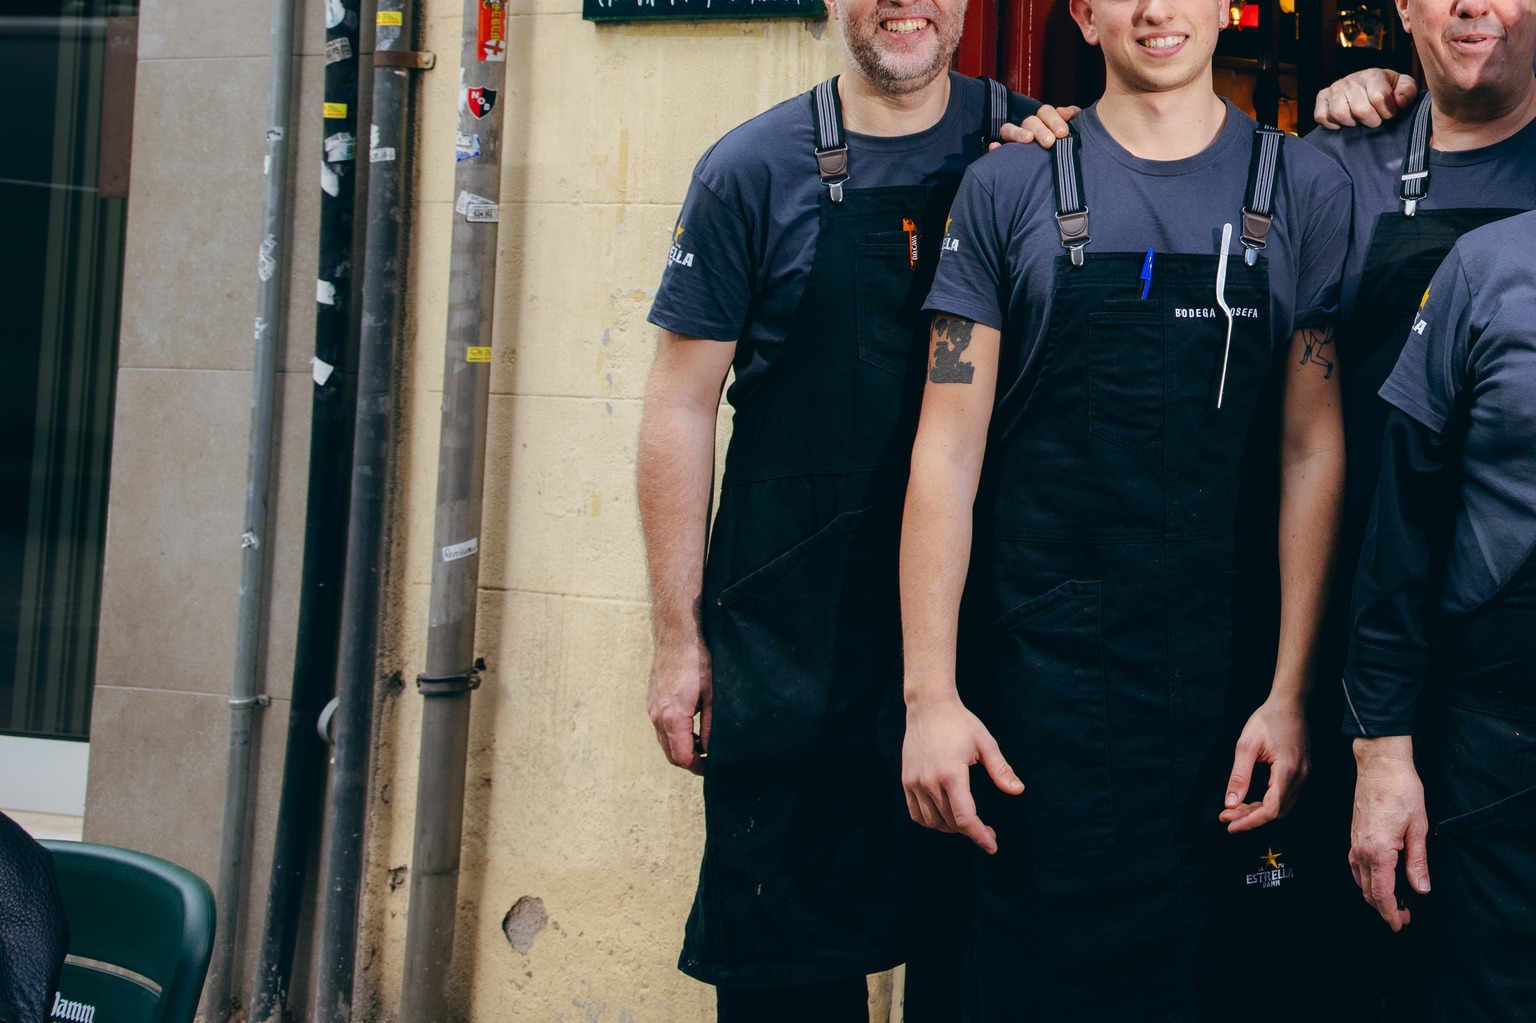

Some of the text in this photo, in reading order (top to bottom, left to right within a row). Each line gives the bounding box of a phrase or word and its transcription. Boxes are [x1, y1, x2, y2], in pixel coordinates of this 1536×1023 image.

[1175, 307, 1258, 319] BODEGA OSEFA
[1246, 868, 1294, 885] ESTRELLA
